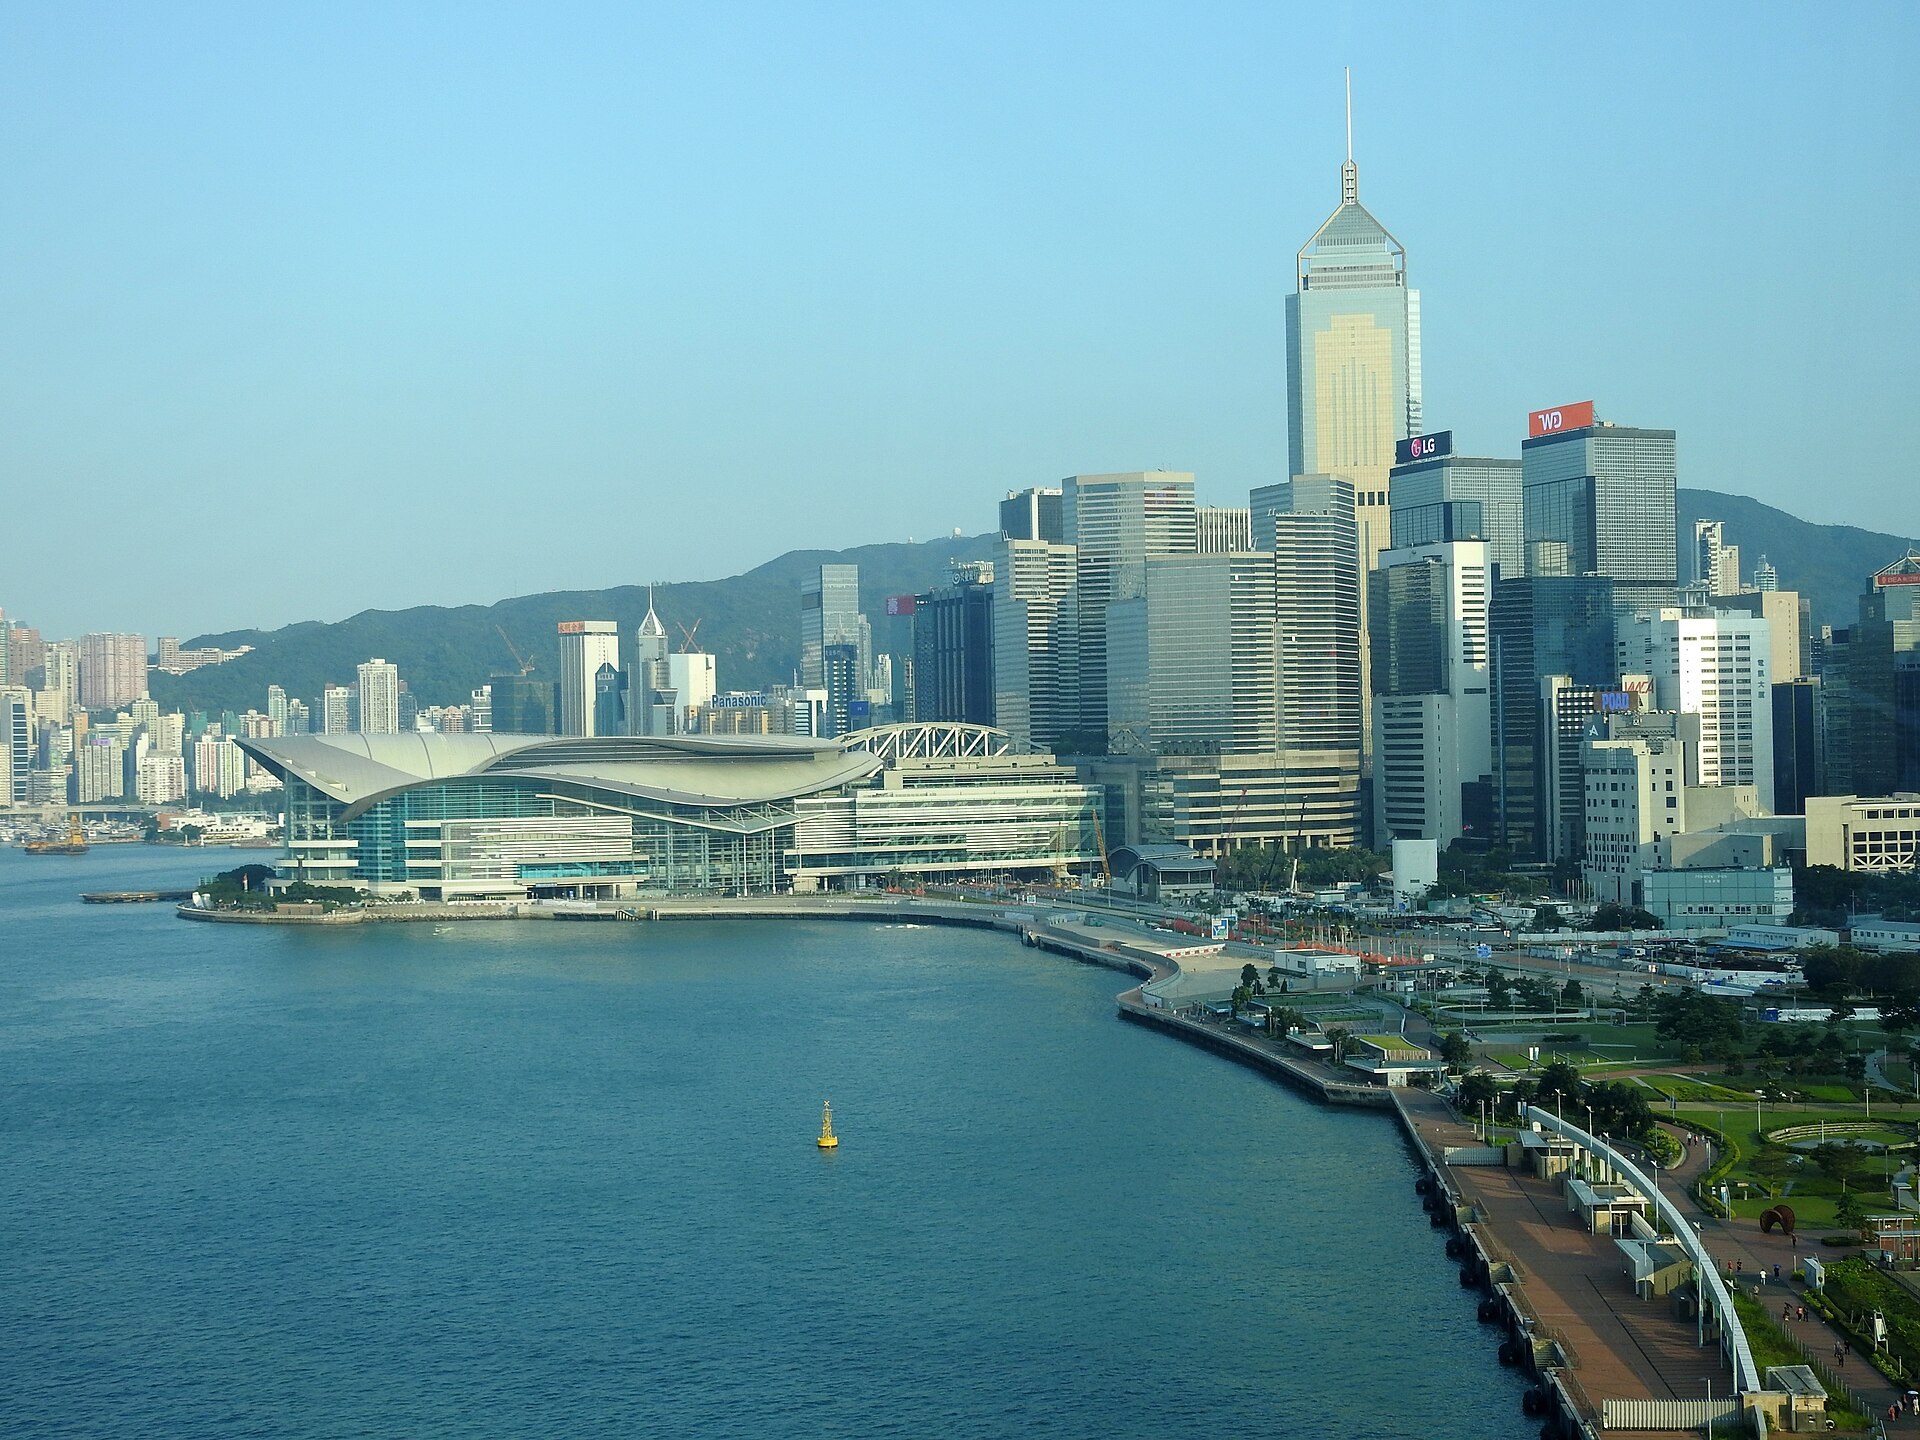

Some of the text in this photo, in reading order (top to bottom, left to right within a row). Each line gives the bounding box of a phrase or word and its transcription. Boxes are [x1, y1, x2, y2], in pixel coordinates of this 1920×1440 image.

[1538, 411, 1562, 431] WD
[1422, 437, 1435, 454] LG
[711, 694, 767, 709] Panasonic
[1601, 692, 1630, 710] POAD
